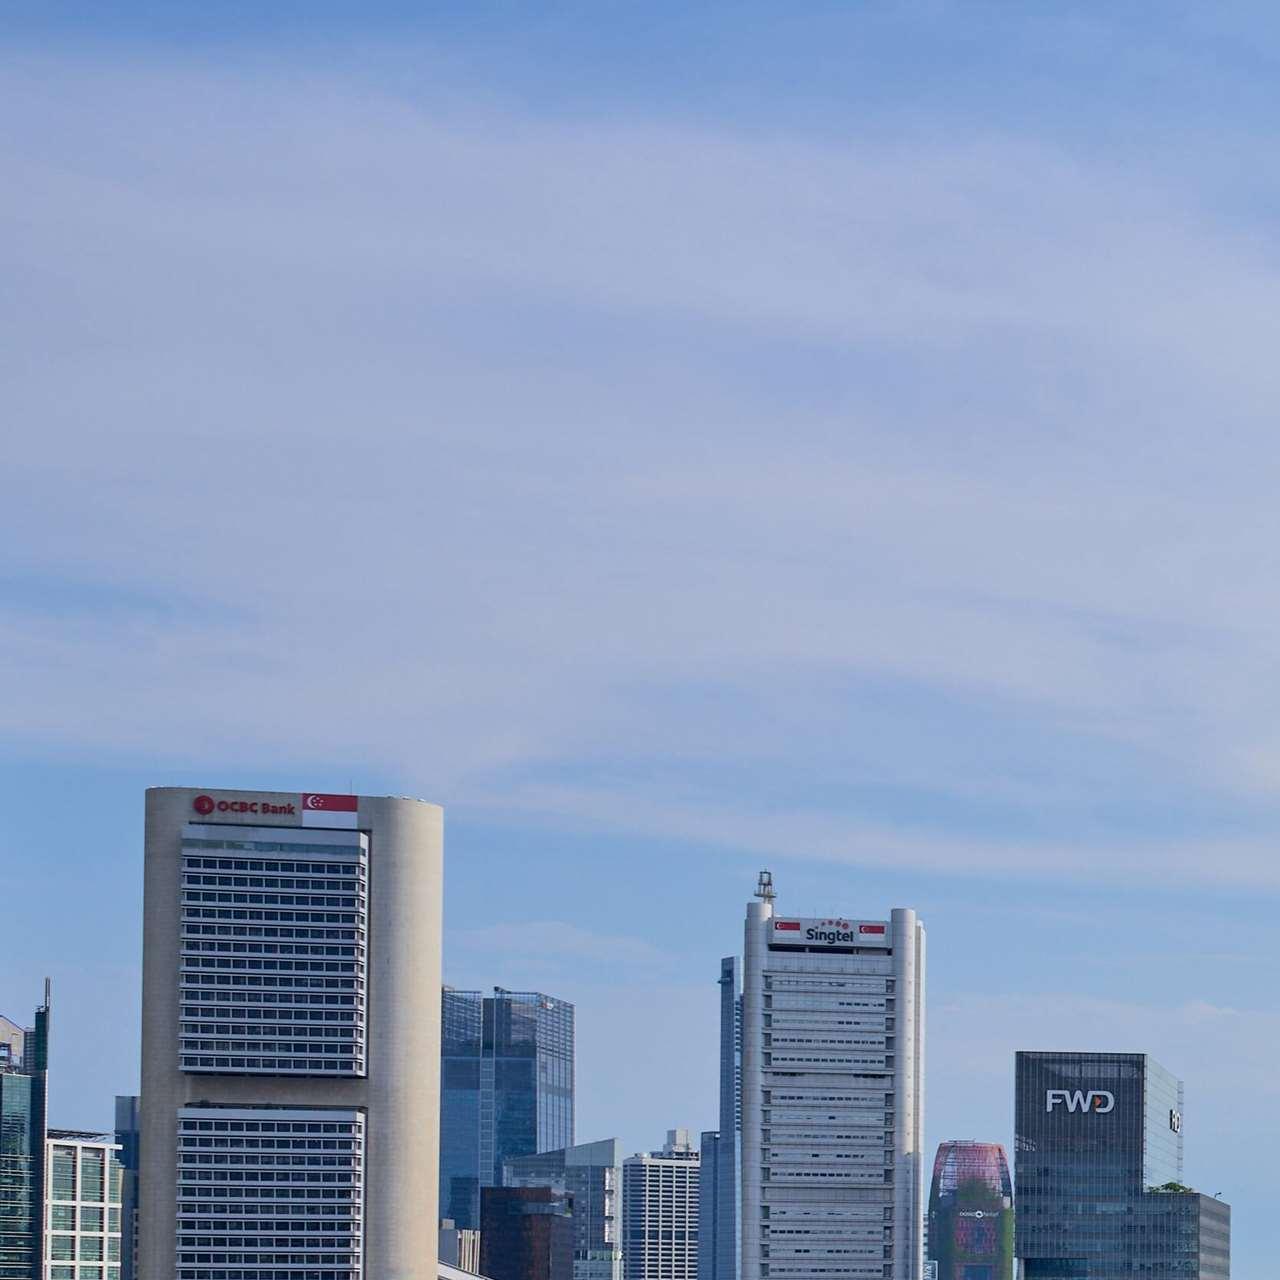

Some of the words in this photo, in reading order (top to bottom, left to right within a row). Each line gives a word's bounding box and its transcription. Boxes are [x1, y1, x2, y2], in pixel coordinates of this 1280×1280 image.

[217, 800, 258, 814] OCBC
[261, 802, 296, 815] Bank
[806, 926, 854, 944] Singtel
[1046, 1089, 1115, 1113] FWD
